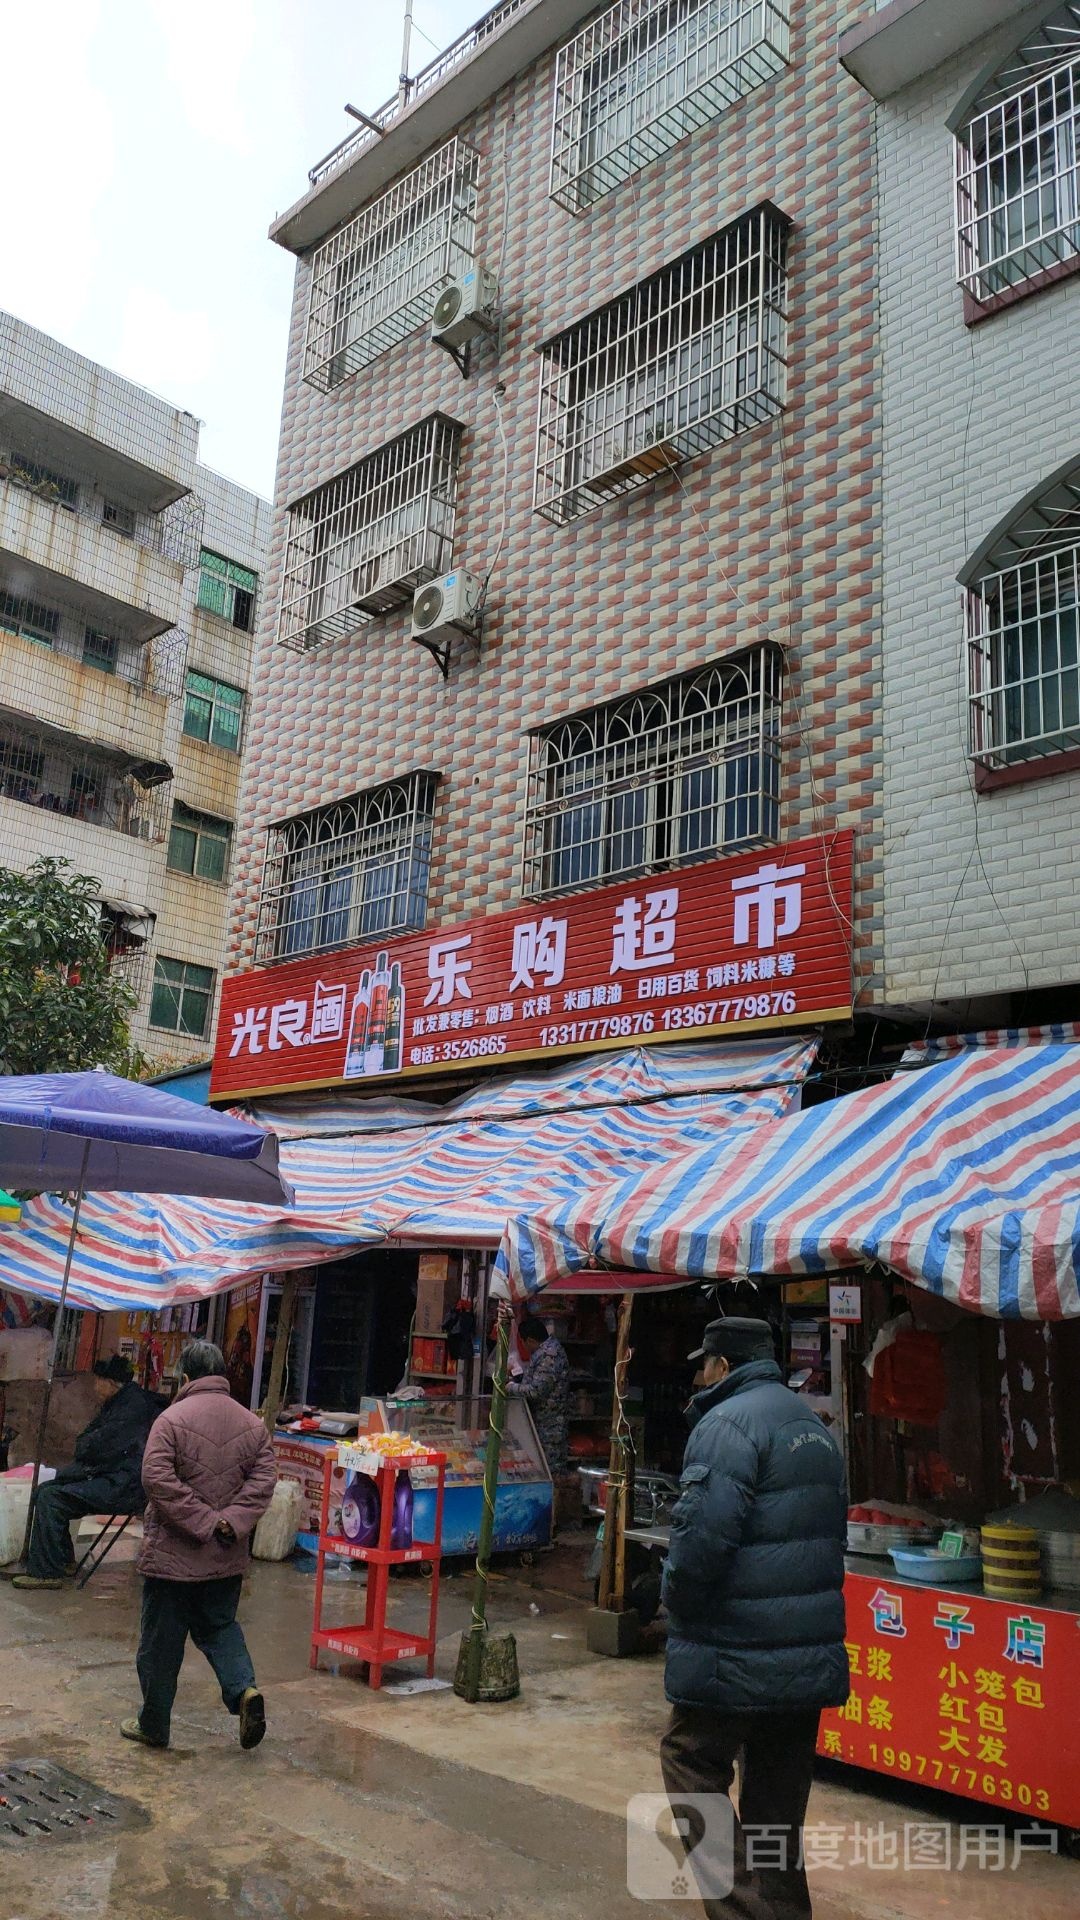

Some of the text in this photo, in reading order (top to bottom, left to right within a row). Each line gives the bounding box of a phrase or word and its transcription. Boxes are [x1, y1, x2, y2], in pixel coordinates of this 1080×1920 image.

[423, 863, 806, 1007] 乐购超市
[485, 1002, 515, 1025] 烟酒
[522, 994, 552, 1020] 饮料
[563, 984, 623, 1011] 米面粮油
[637, 968, 700, 1000] 日用百货
[706, 951, 797, 991] 饲料米糠等
[228, 980, 346, 1057] 光良酒
[539, 1011, 655, 1047] 13317779876
[661, 991, 797, 1030] 13367779876
[868, 1587, 1046, 1669] 包子店
[844, 1642, 893, 1682] 豆浆
[938, 1661, 1046, 1709] 小笼包
[838, 1690, 894, 1731] 油条
[939, 1692, 1008, 1734] 红包
[939, 1726, 1009, 1768] 大发
